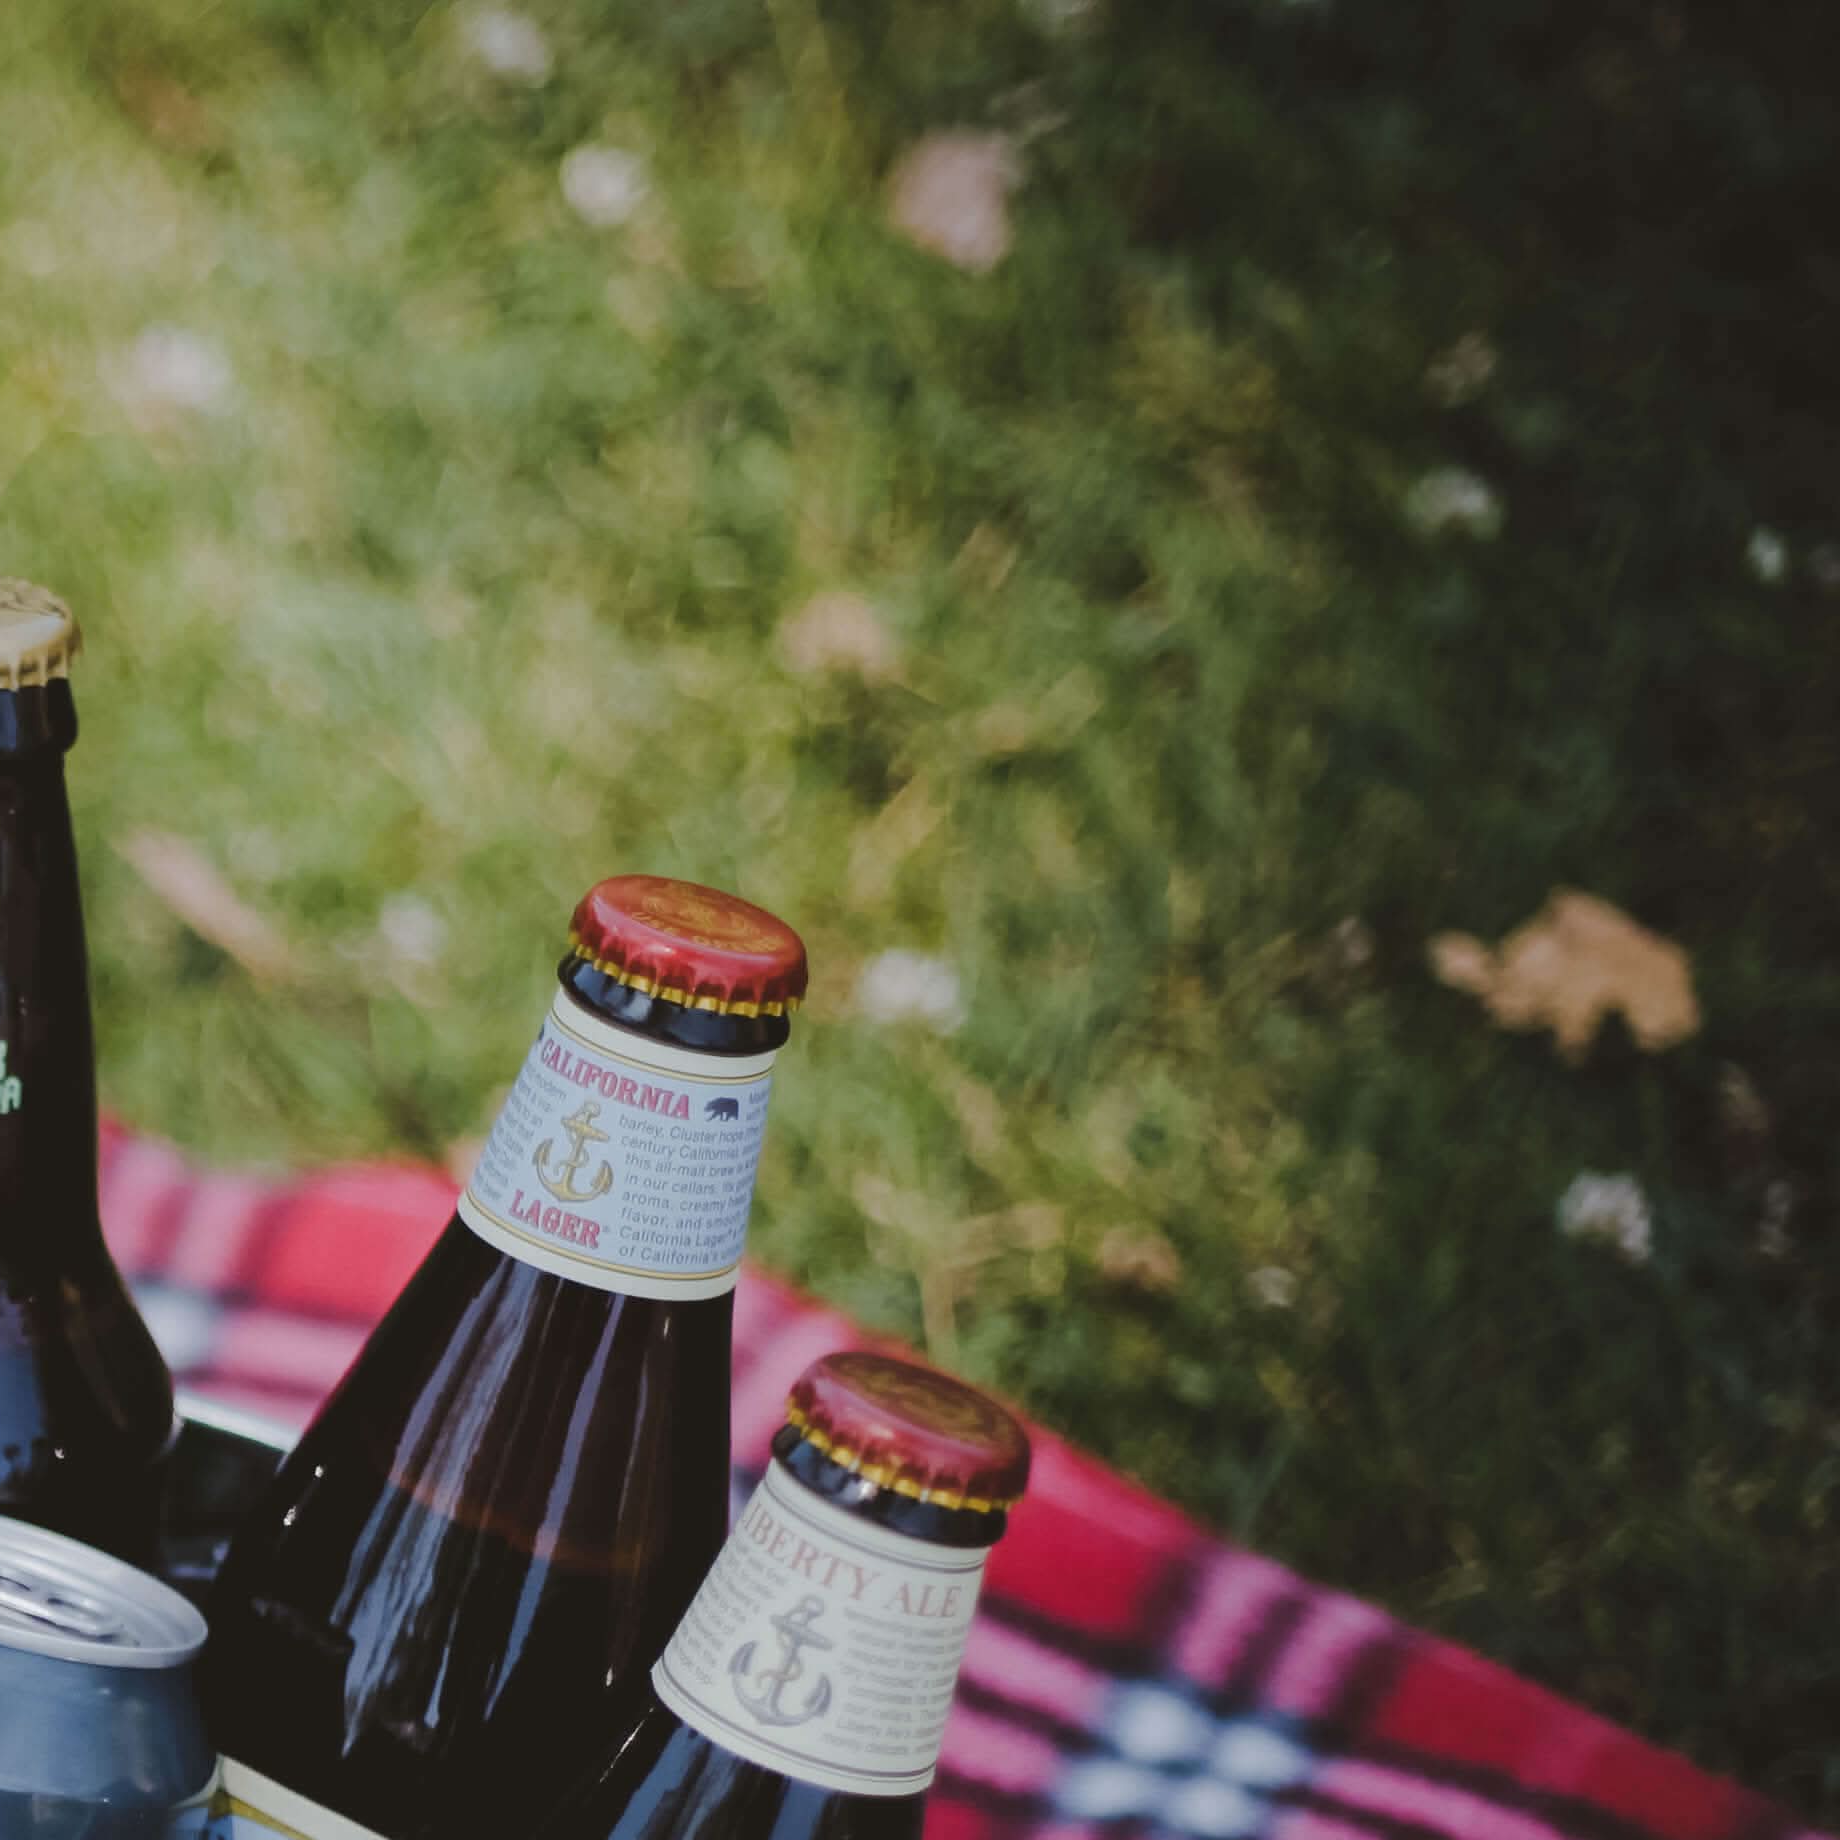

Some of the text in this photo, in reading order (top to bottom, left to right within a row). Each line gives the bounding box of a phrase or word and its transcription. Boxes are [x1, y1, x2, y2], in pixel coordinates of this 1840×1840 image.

[540, 1037, 691, 1121] CALIFORNIA
[621, 1135, 672, 1156] century
[625, 1152, 651, 1170] this
[643, 1177, 668, 1190] our
[508, 1188, 601, 1250] LAGER
[619, 1225, 691, 1247] California
[884, 1582, 963, 1618] ALE
